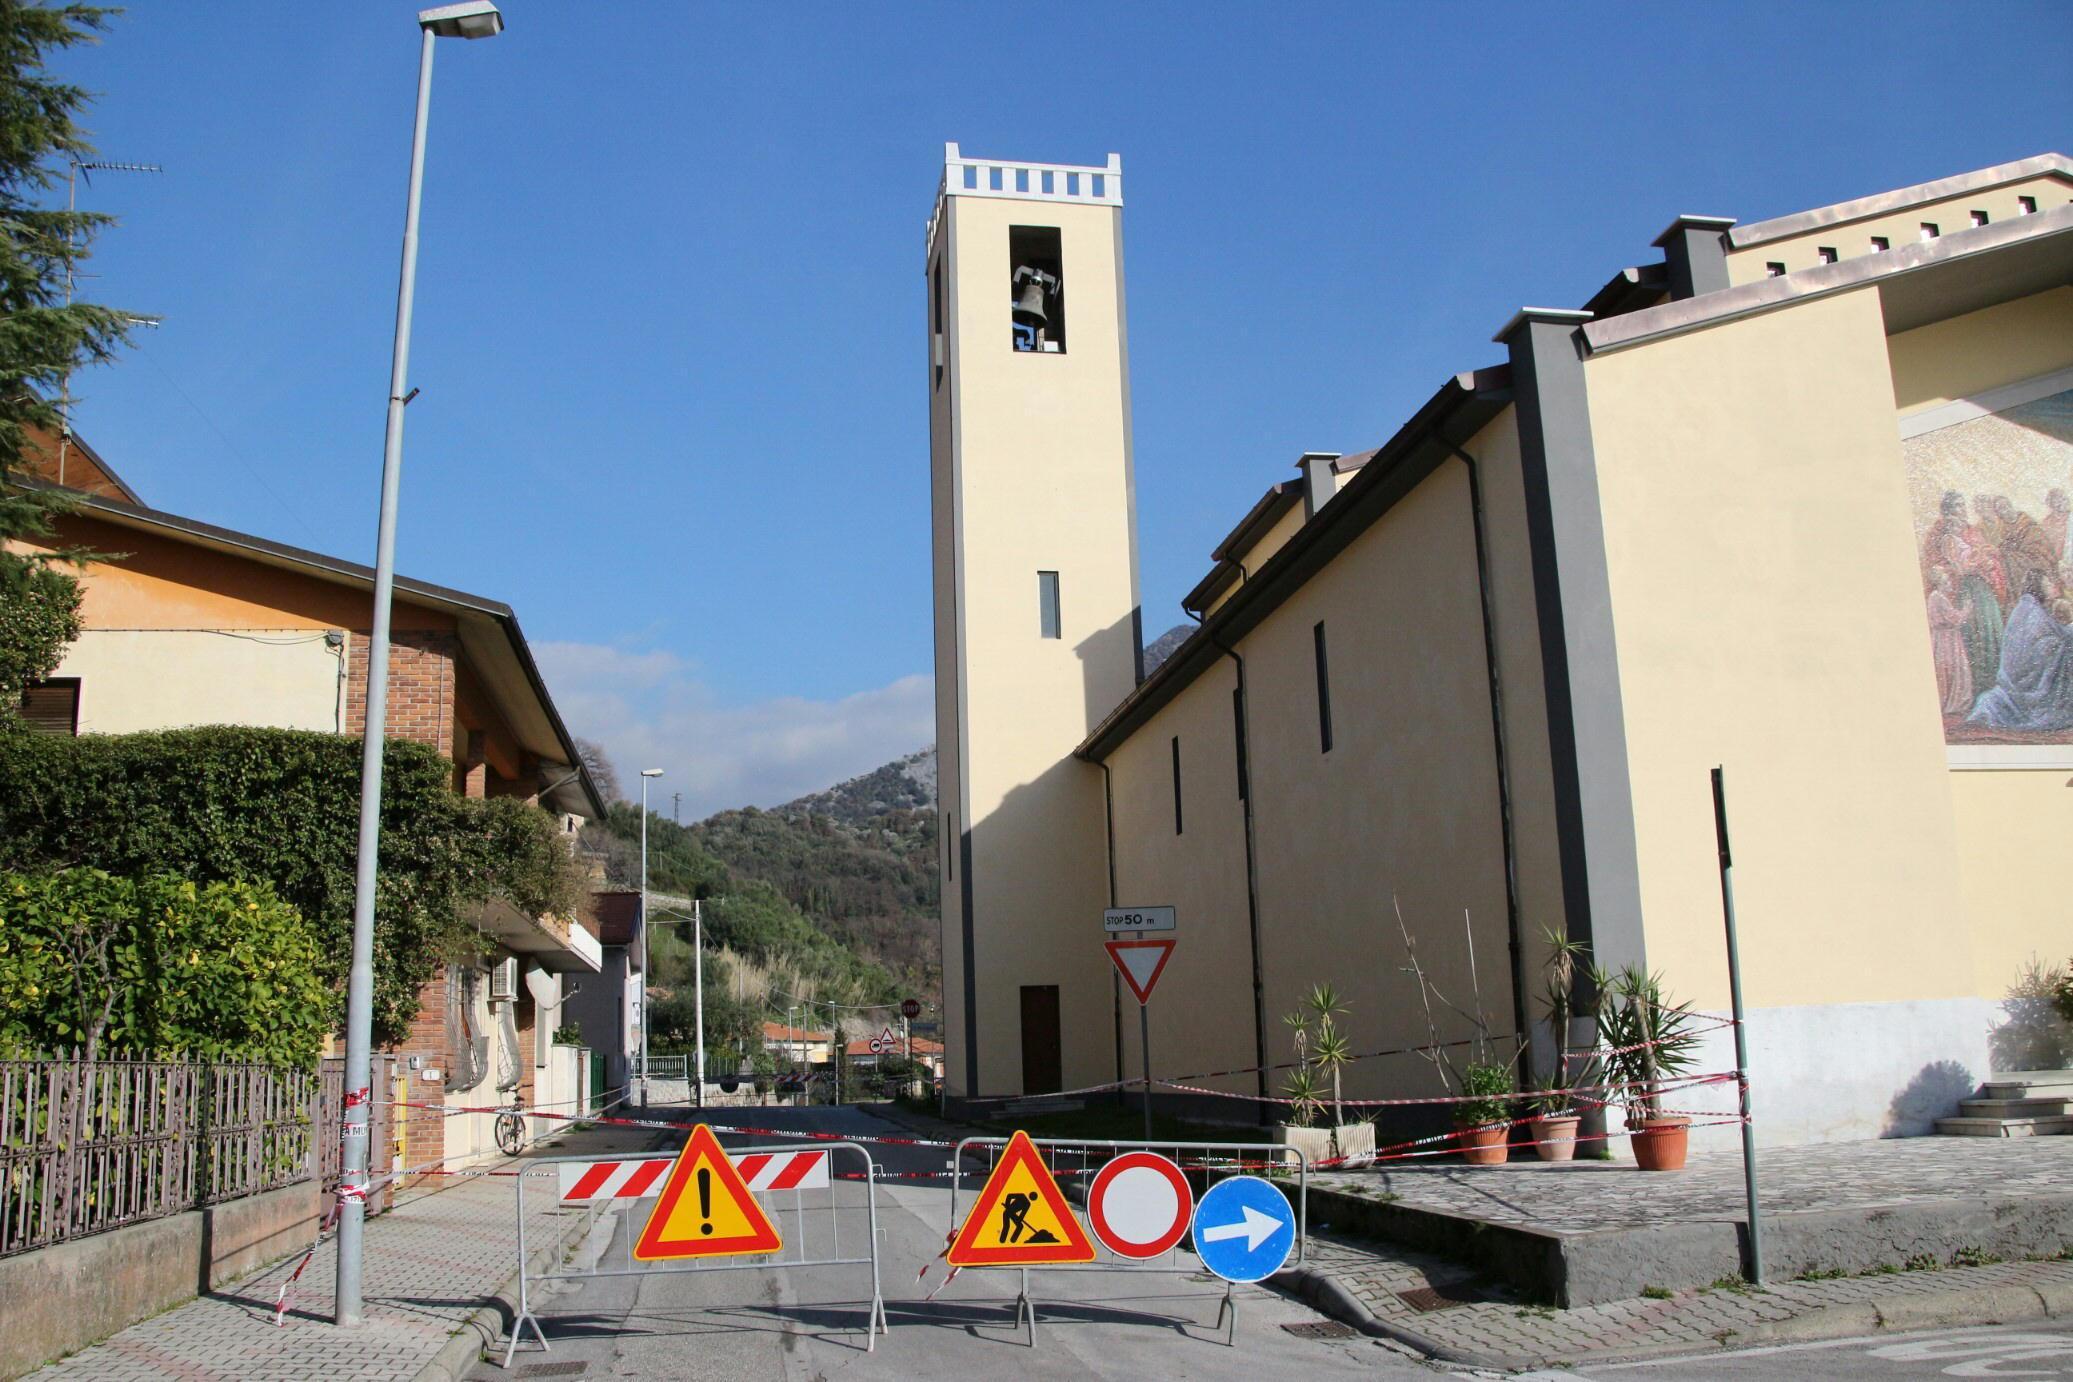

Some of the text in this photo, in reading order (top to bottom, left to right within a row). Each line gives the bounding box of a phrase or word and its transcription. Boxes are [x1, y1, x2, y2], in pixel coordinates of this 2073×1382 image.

[1106, 916, 1123, 925] STOP
[1124, 914, 1142, 925] 50
[902, 1004, 919, 1014] STOP
